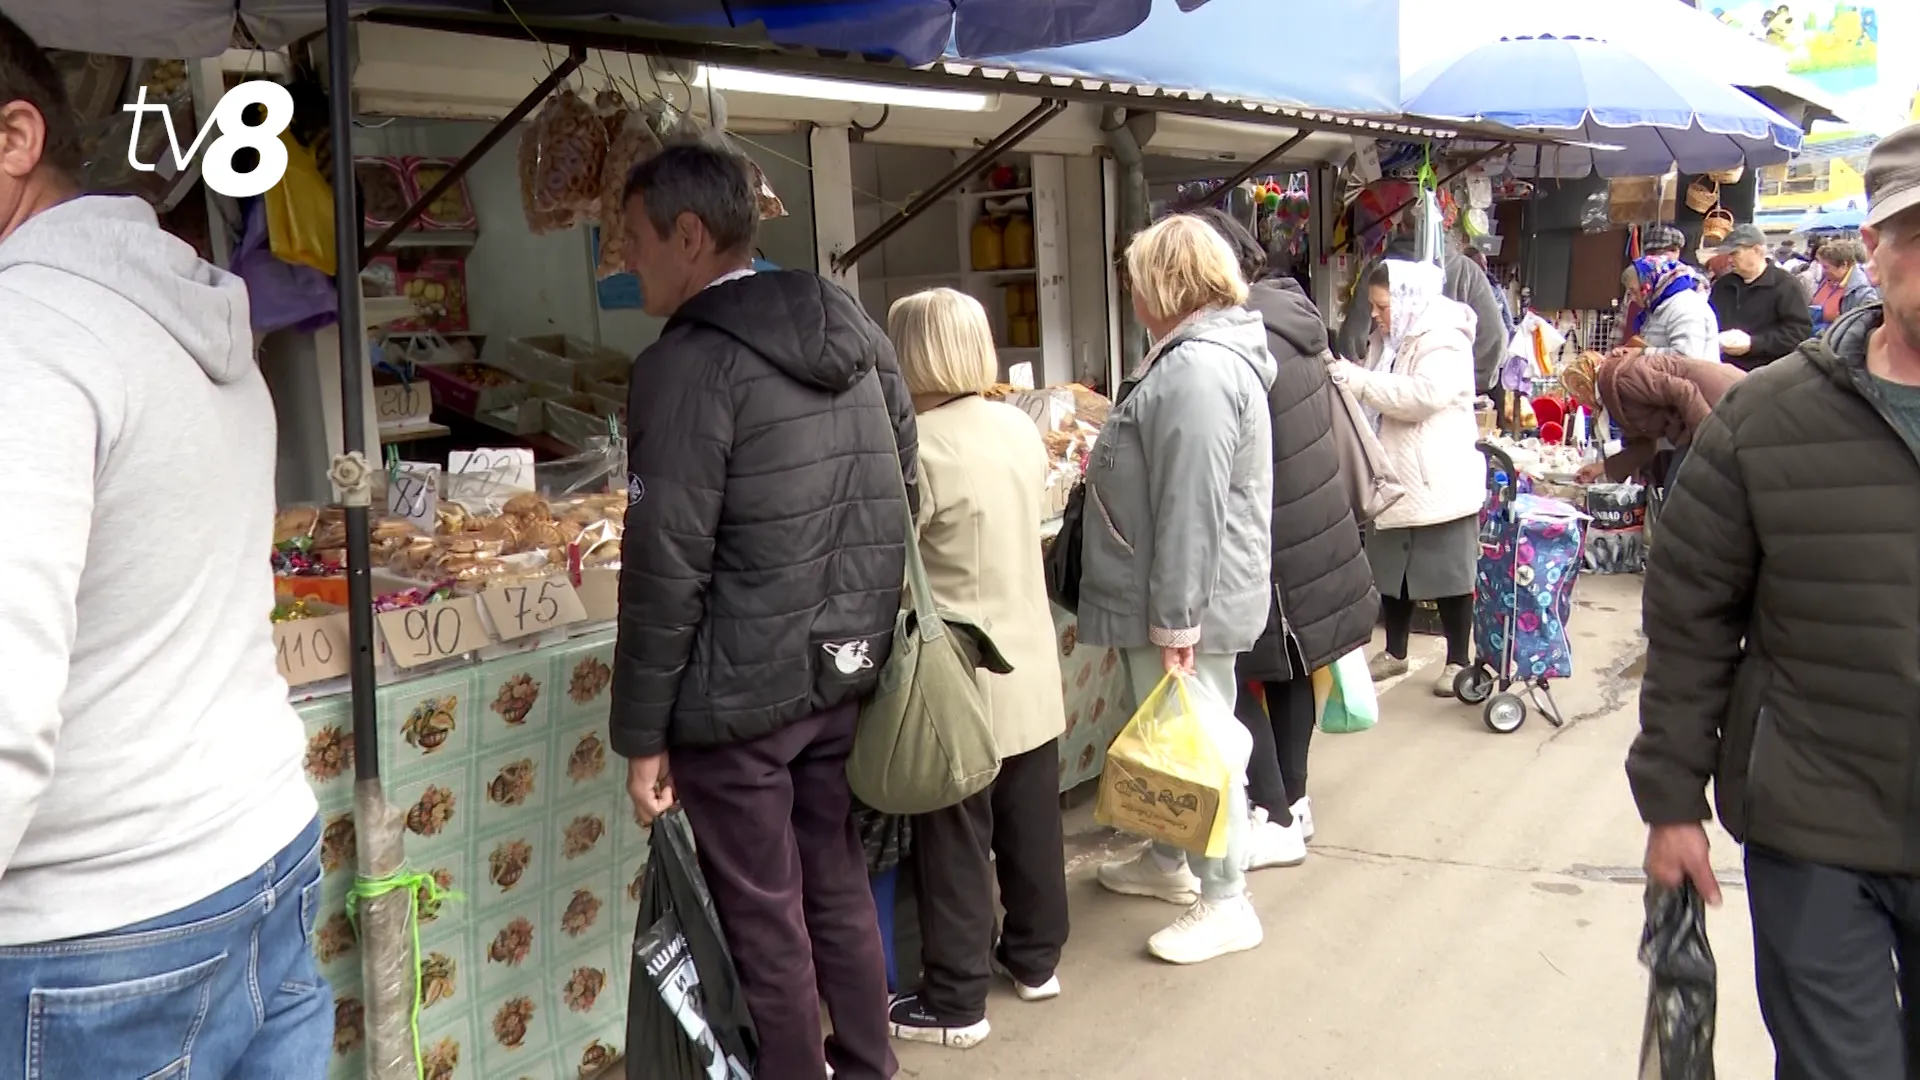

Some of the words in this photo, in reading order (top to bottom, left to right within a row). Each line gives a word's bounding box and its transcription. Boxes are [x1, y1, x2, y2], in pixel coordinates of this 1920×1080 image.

[381, 387, 420, 417] 200
[504, 581, 568, 631] 75
[279, 628, 333, 673] 110
[404, 606, 461, 656] 90
